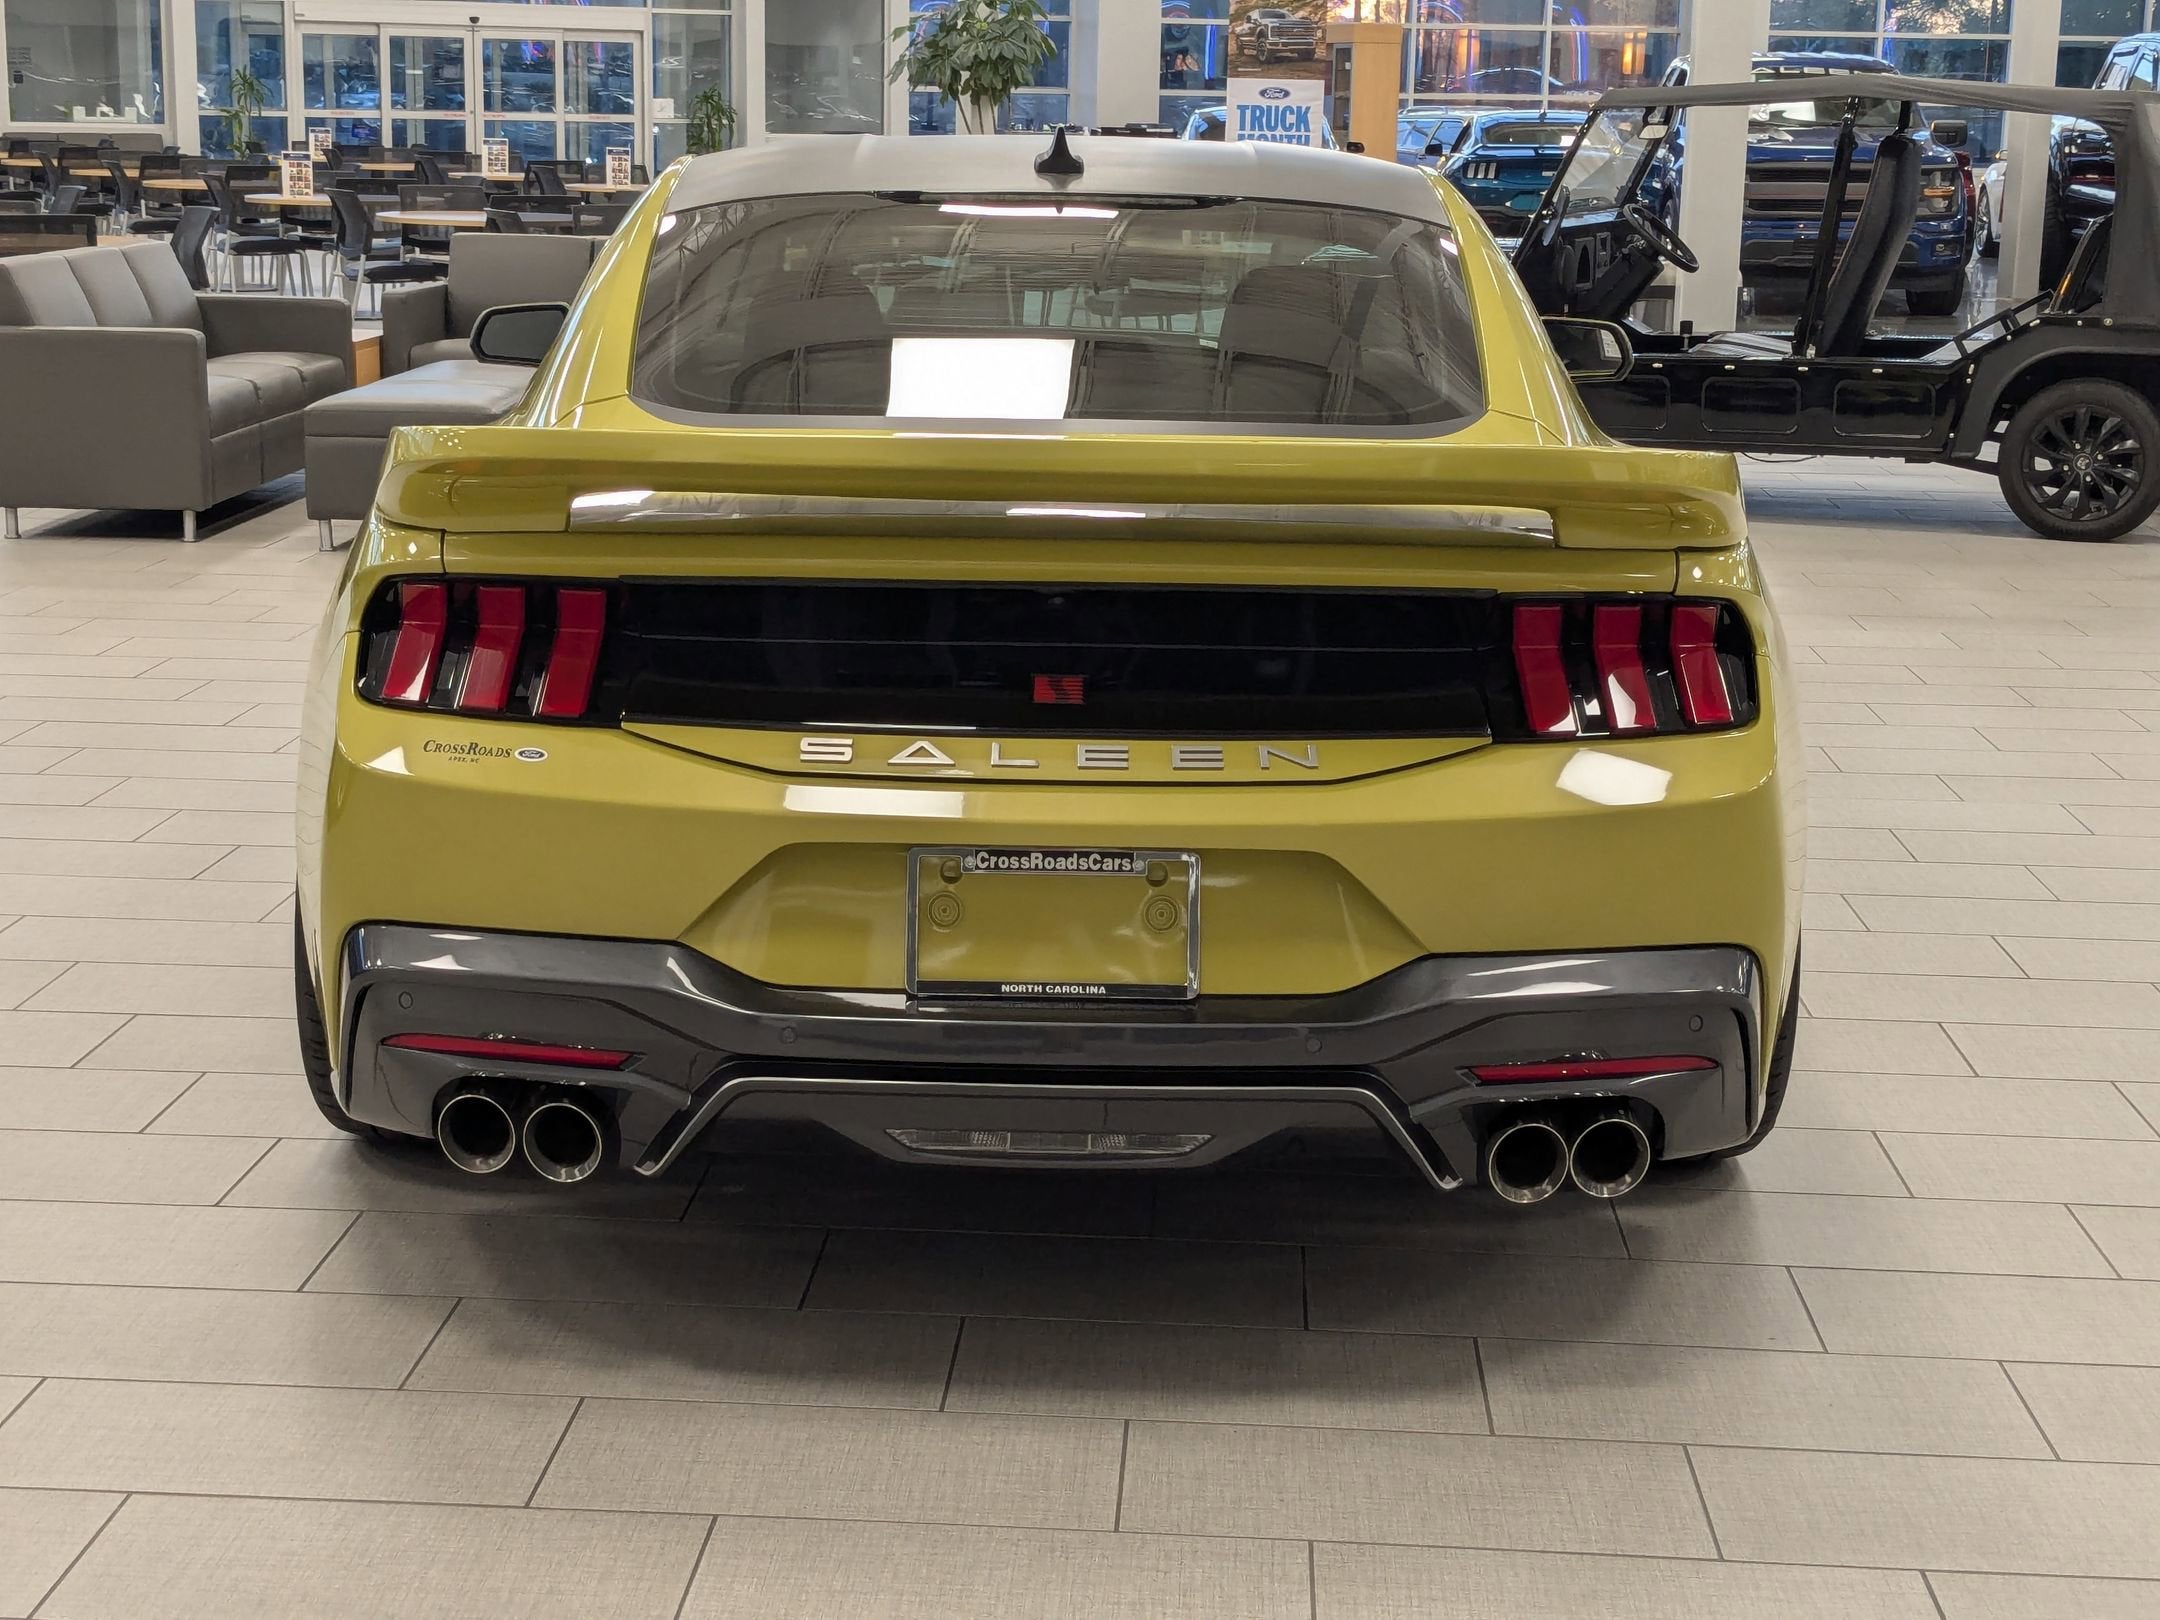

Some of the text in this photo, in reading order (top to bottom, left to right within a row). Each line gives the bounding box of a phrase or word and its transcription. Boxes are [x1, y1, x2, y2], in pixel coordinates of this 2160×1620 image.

[1236, 104, 1311, 132] TRUCK
[800, 737, 1318, 769] SALEEN
[1001, 984, 1106, 994] NORTH CAROLINA
